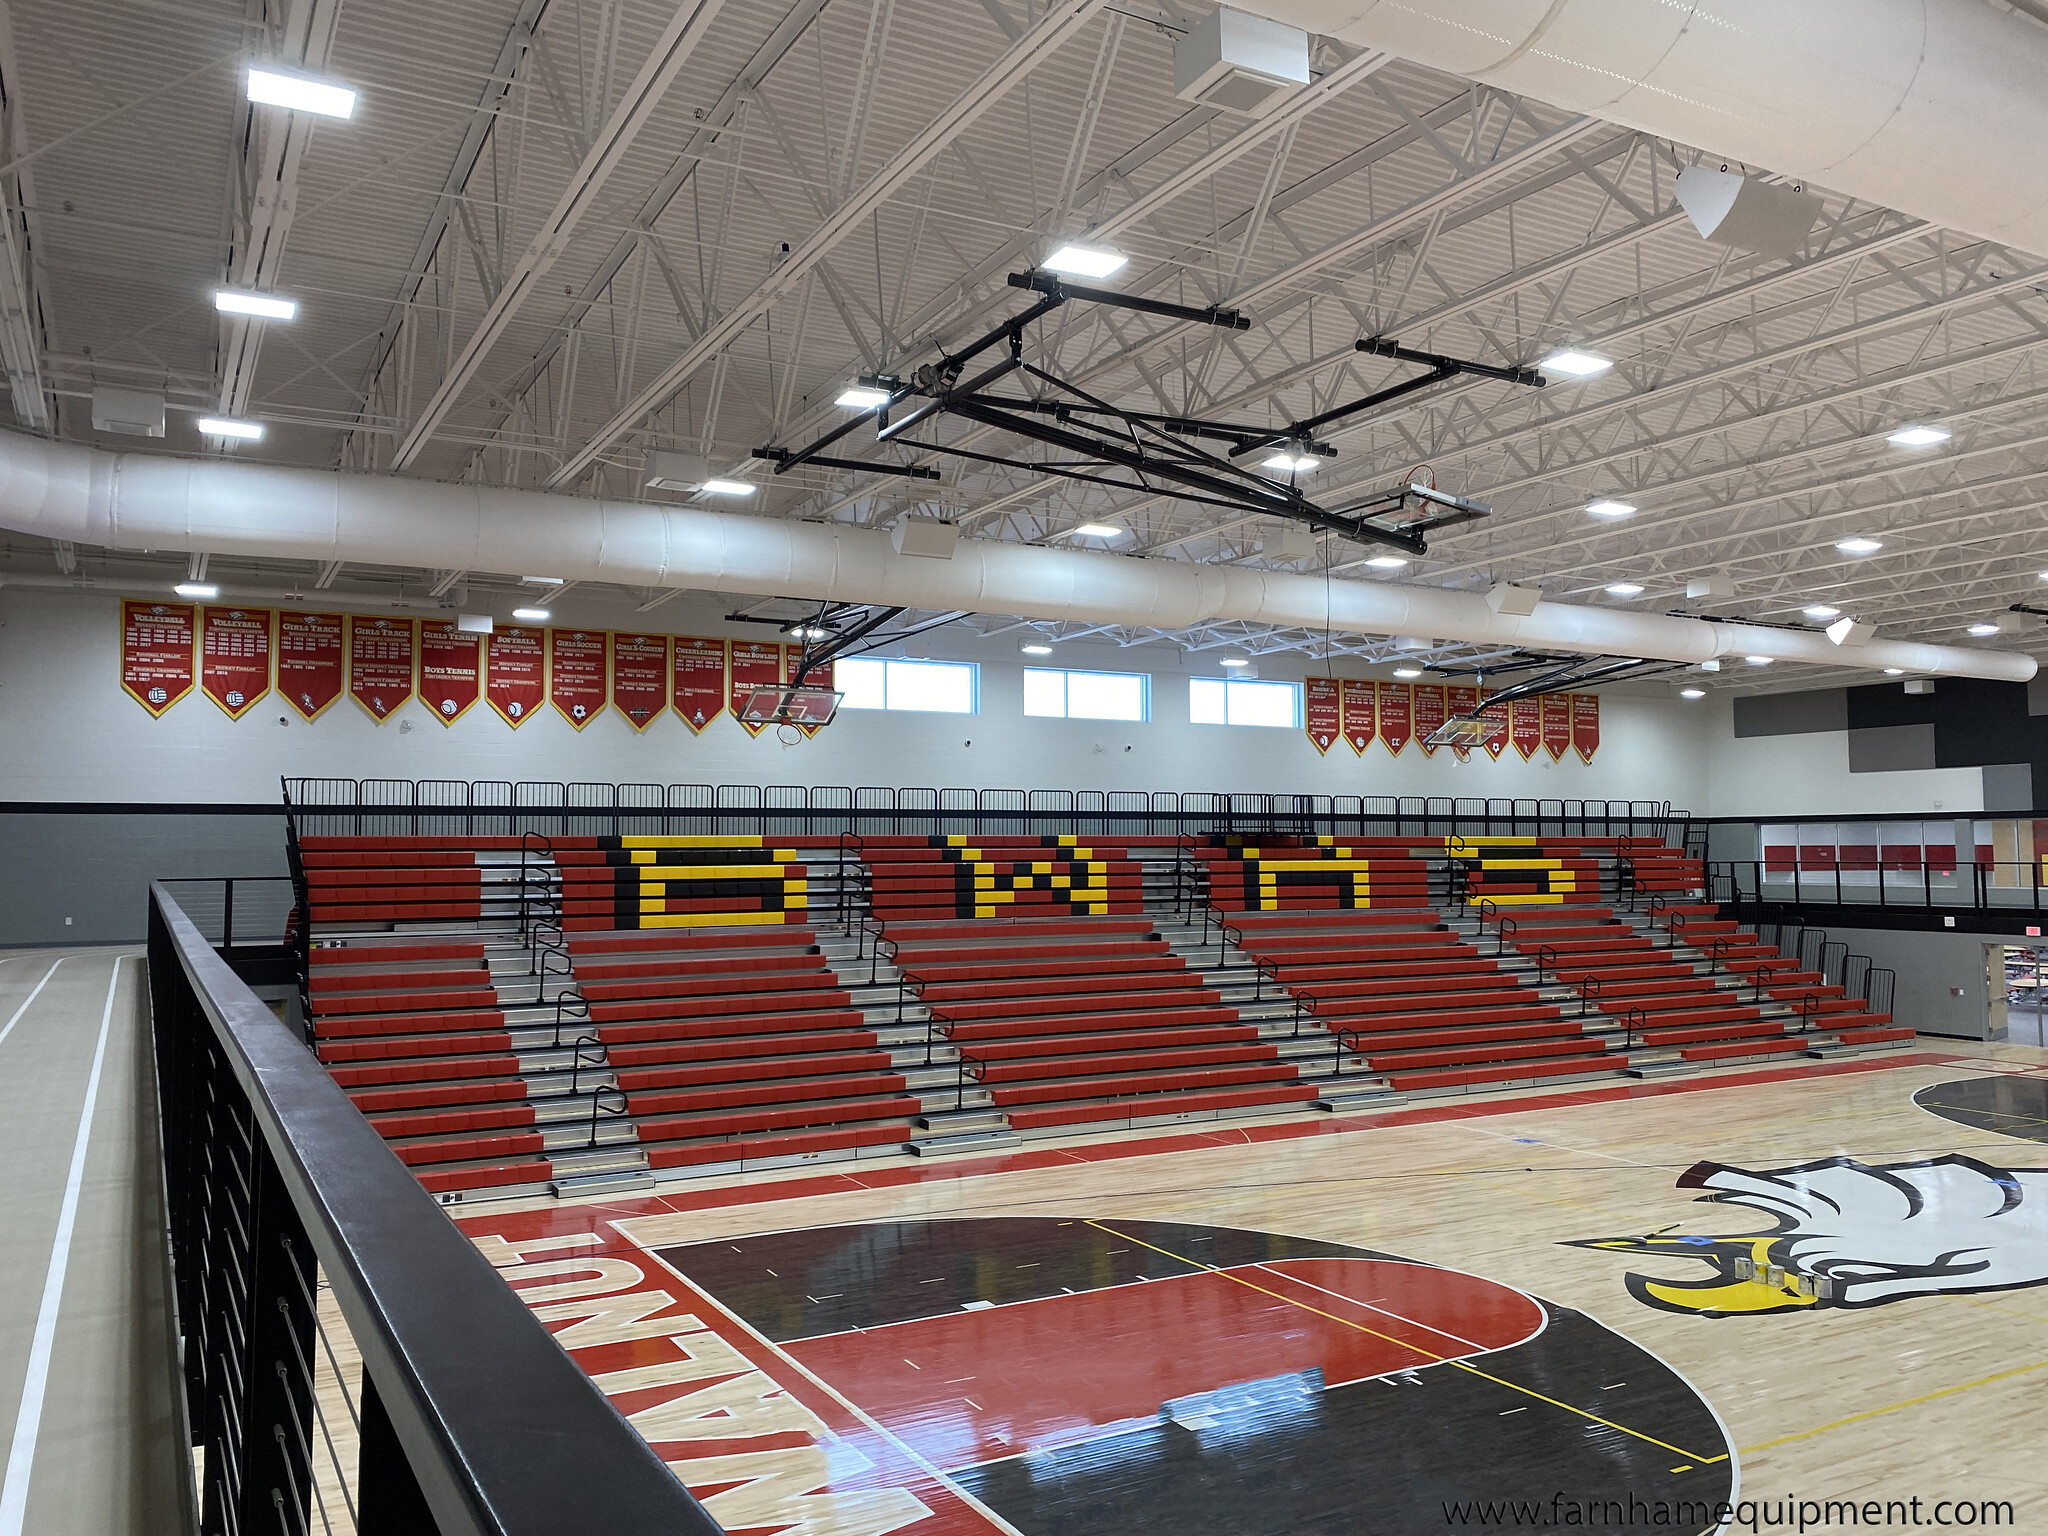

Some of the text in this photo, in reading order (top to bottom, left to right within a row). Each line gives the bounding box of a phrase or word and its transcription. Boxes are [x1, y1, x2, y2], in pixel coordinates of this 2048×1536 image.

[134, 614, 185, 624] VOLLEYBALL
[213, 619, 261, 628] VOLLEYBALL
[382, 629, 409, 637] TRACK
[449, 633, 477, 641] TENNIS
[633, 645, 664, 653] X-COUNTRY
[676, 647, 722, 656] CHEERLEADING
[752, 652, 777, 660] BOWLING
